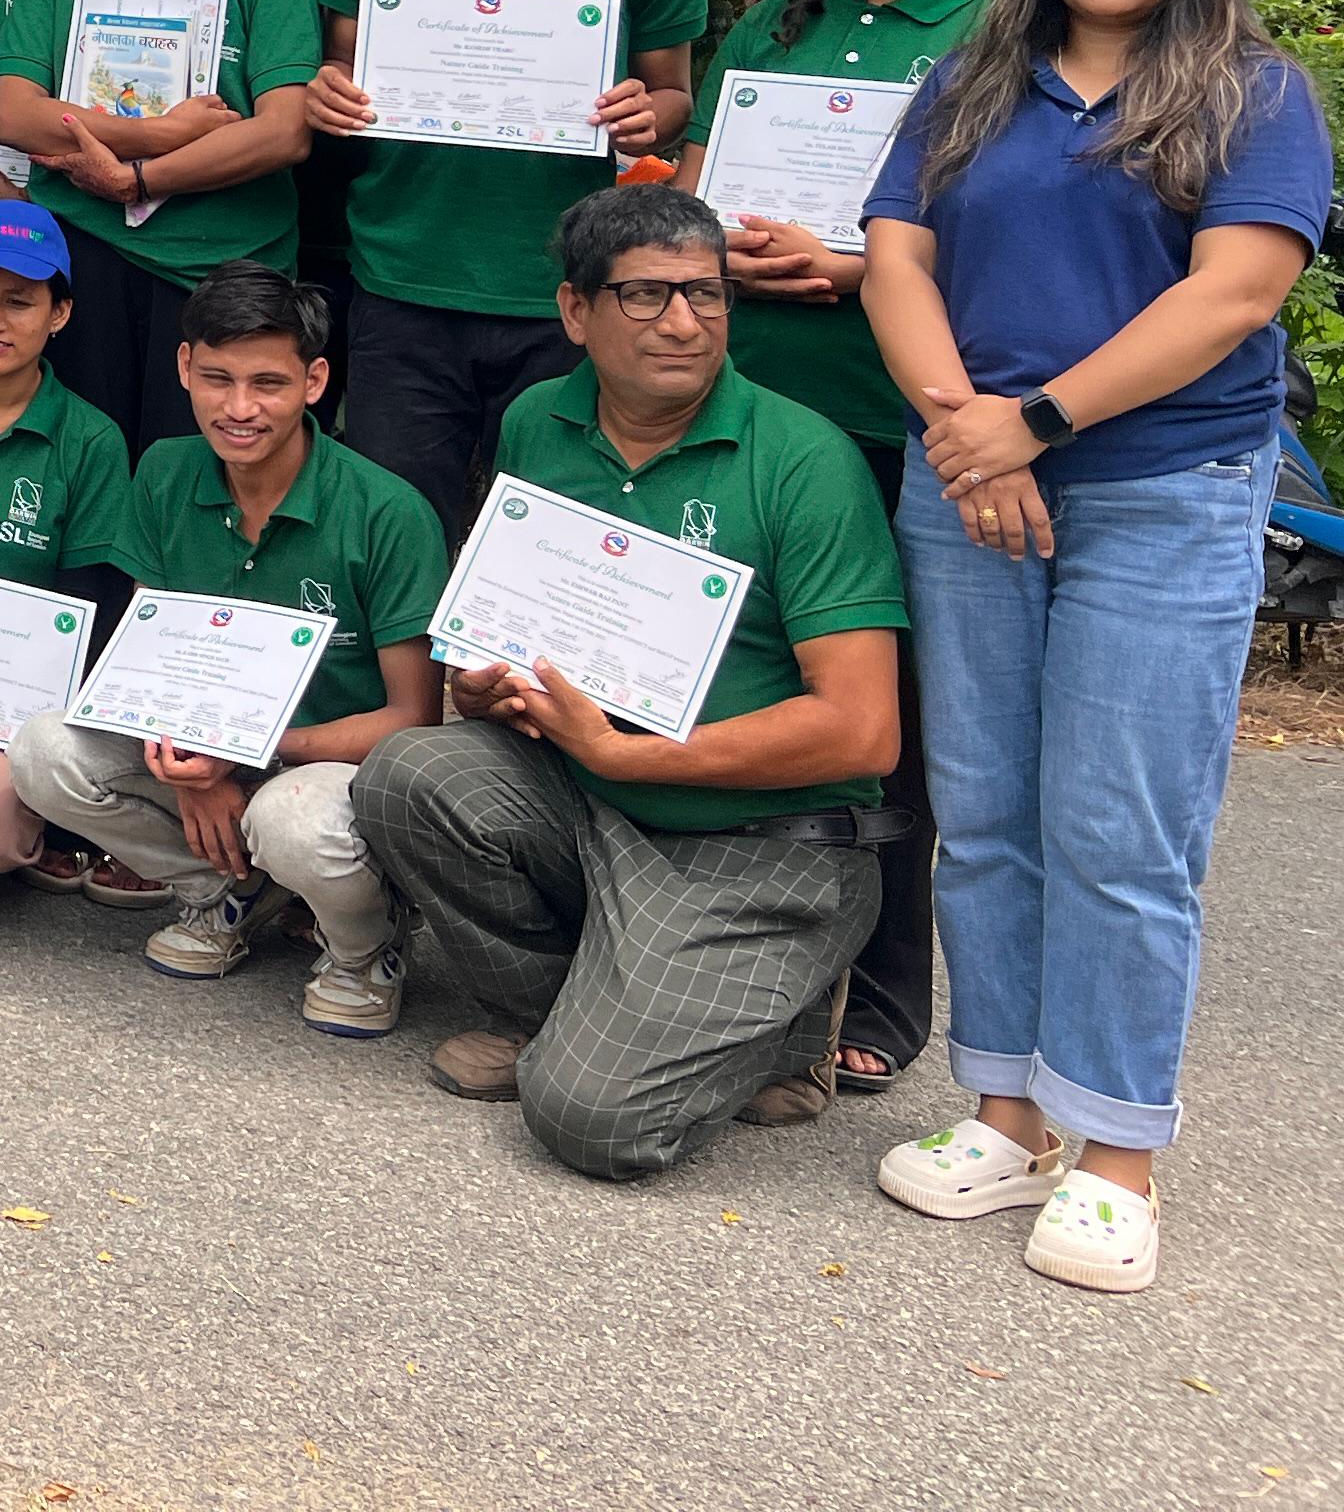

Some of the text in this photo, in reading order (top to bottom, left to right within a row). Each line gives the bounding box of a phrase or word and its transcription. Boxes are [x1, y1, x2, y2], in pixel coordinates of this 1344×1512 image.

[496, 125, 525, 138] ZSL
[831, 224, 858, 238] ZSL
[589, 560, 605, 574] of
[580, 675, 609, 694] ZSL
